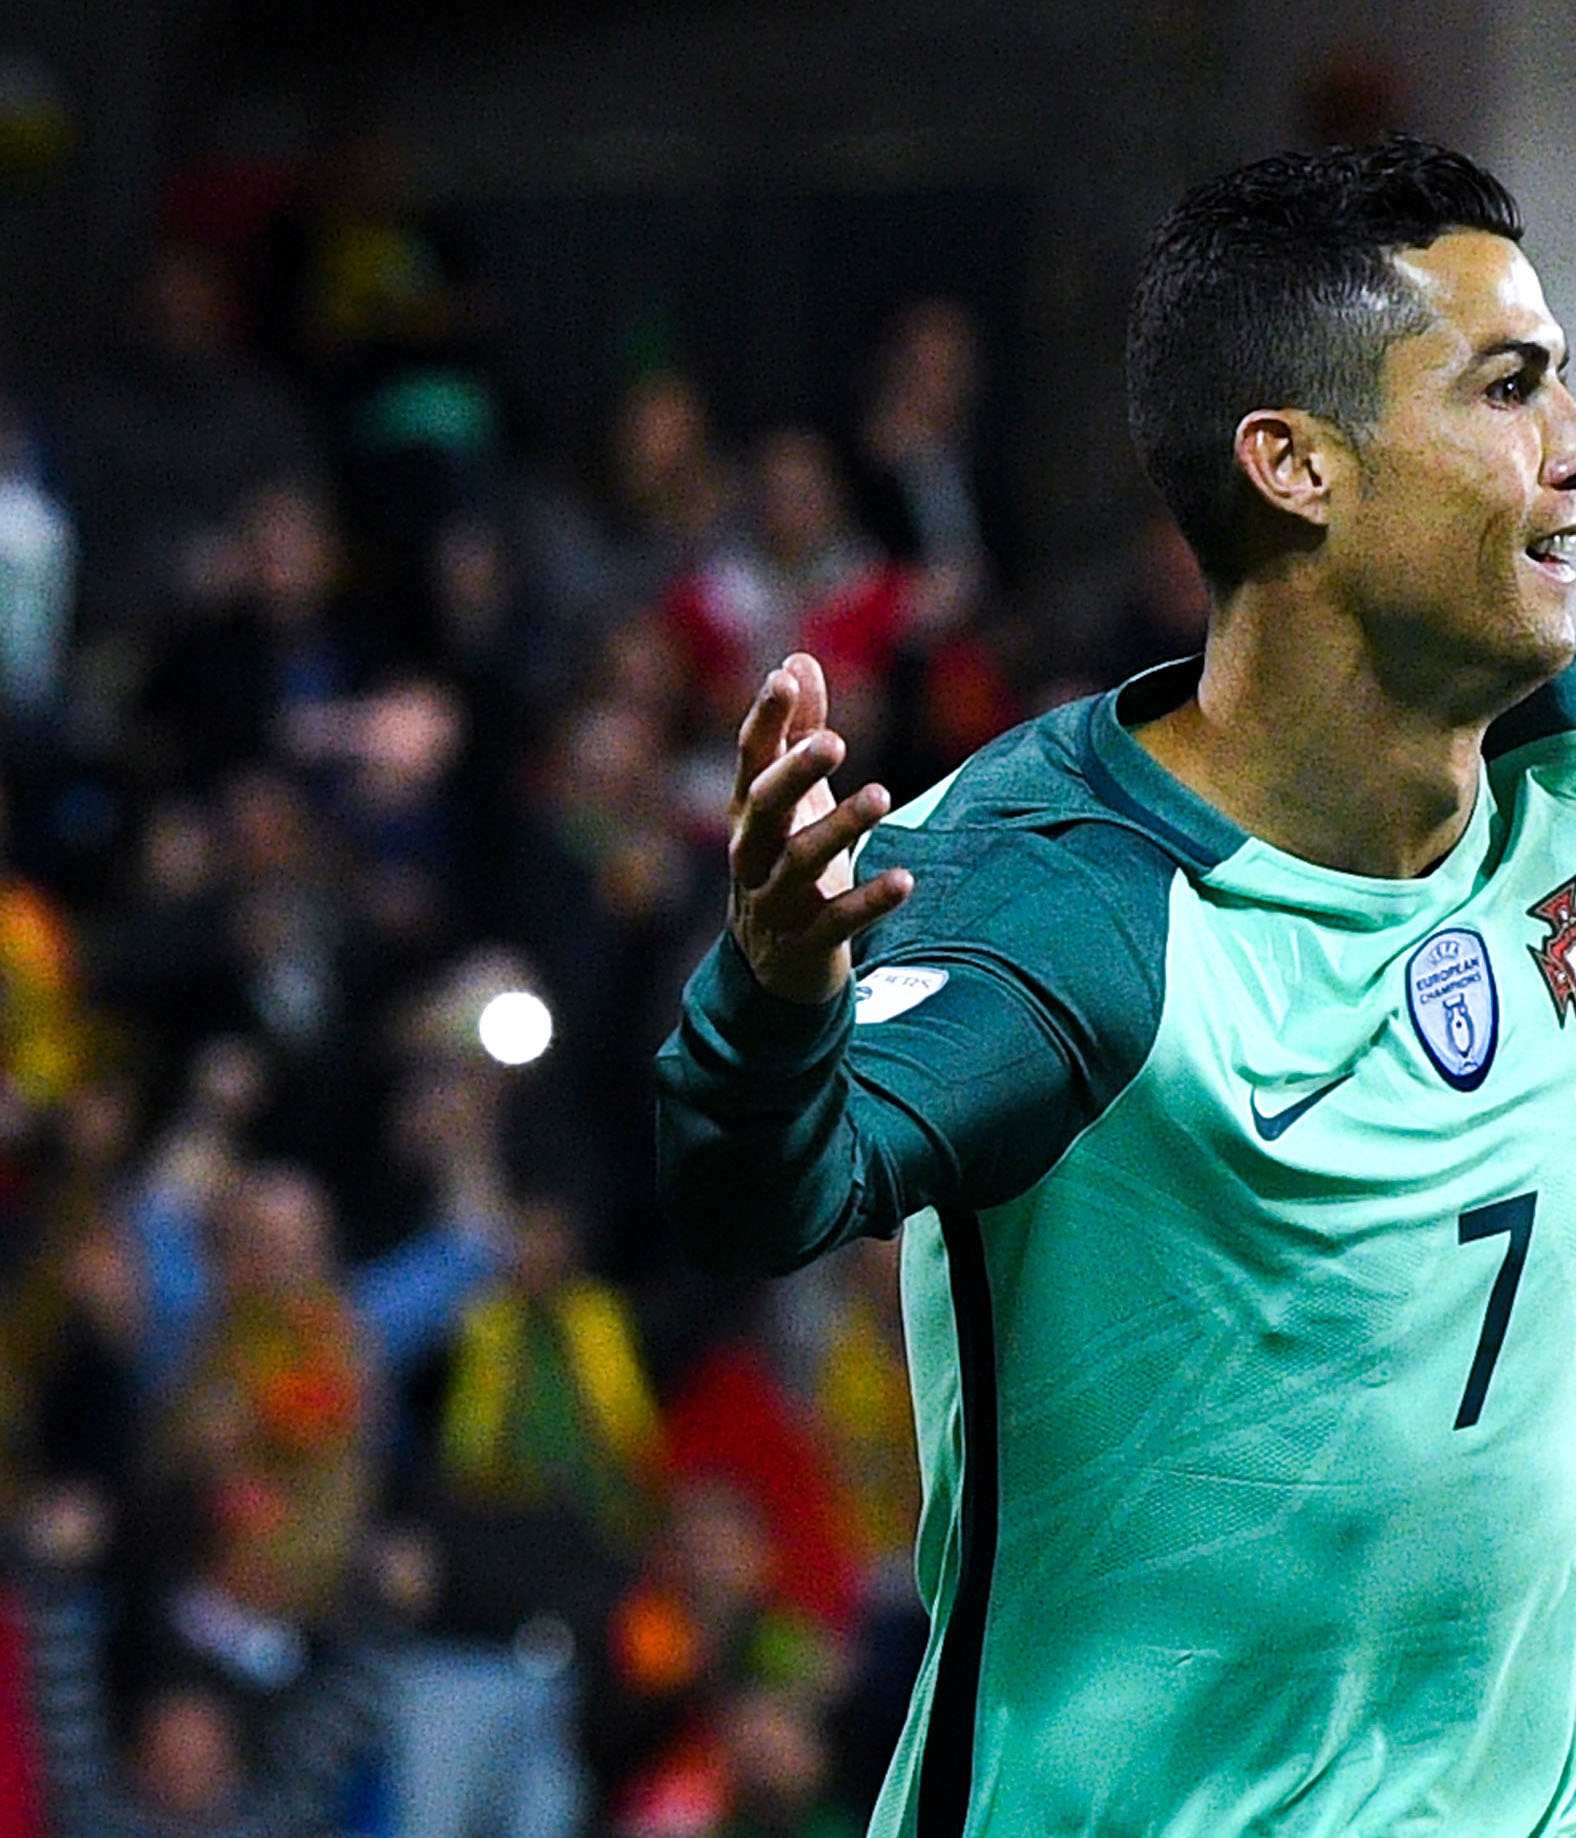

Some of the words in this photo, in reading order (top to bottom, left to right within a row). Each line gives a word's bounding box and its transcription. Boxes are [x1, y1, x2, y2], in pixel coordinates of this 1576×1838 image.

[1416, 956, 1479, 991] EUROPEAN
[1419, 971, 1482, 1004] CHAMPIONS
[1453, 1190, 1538, 1431] 7
